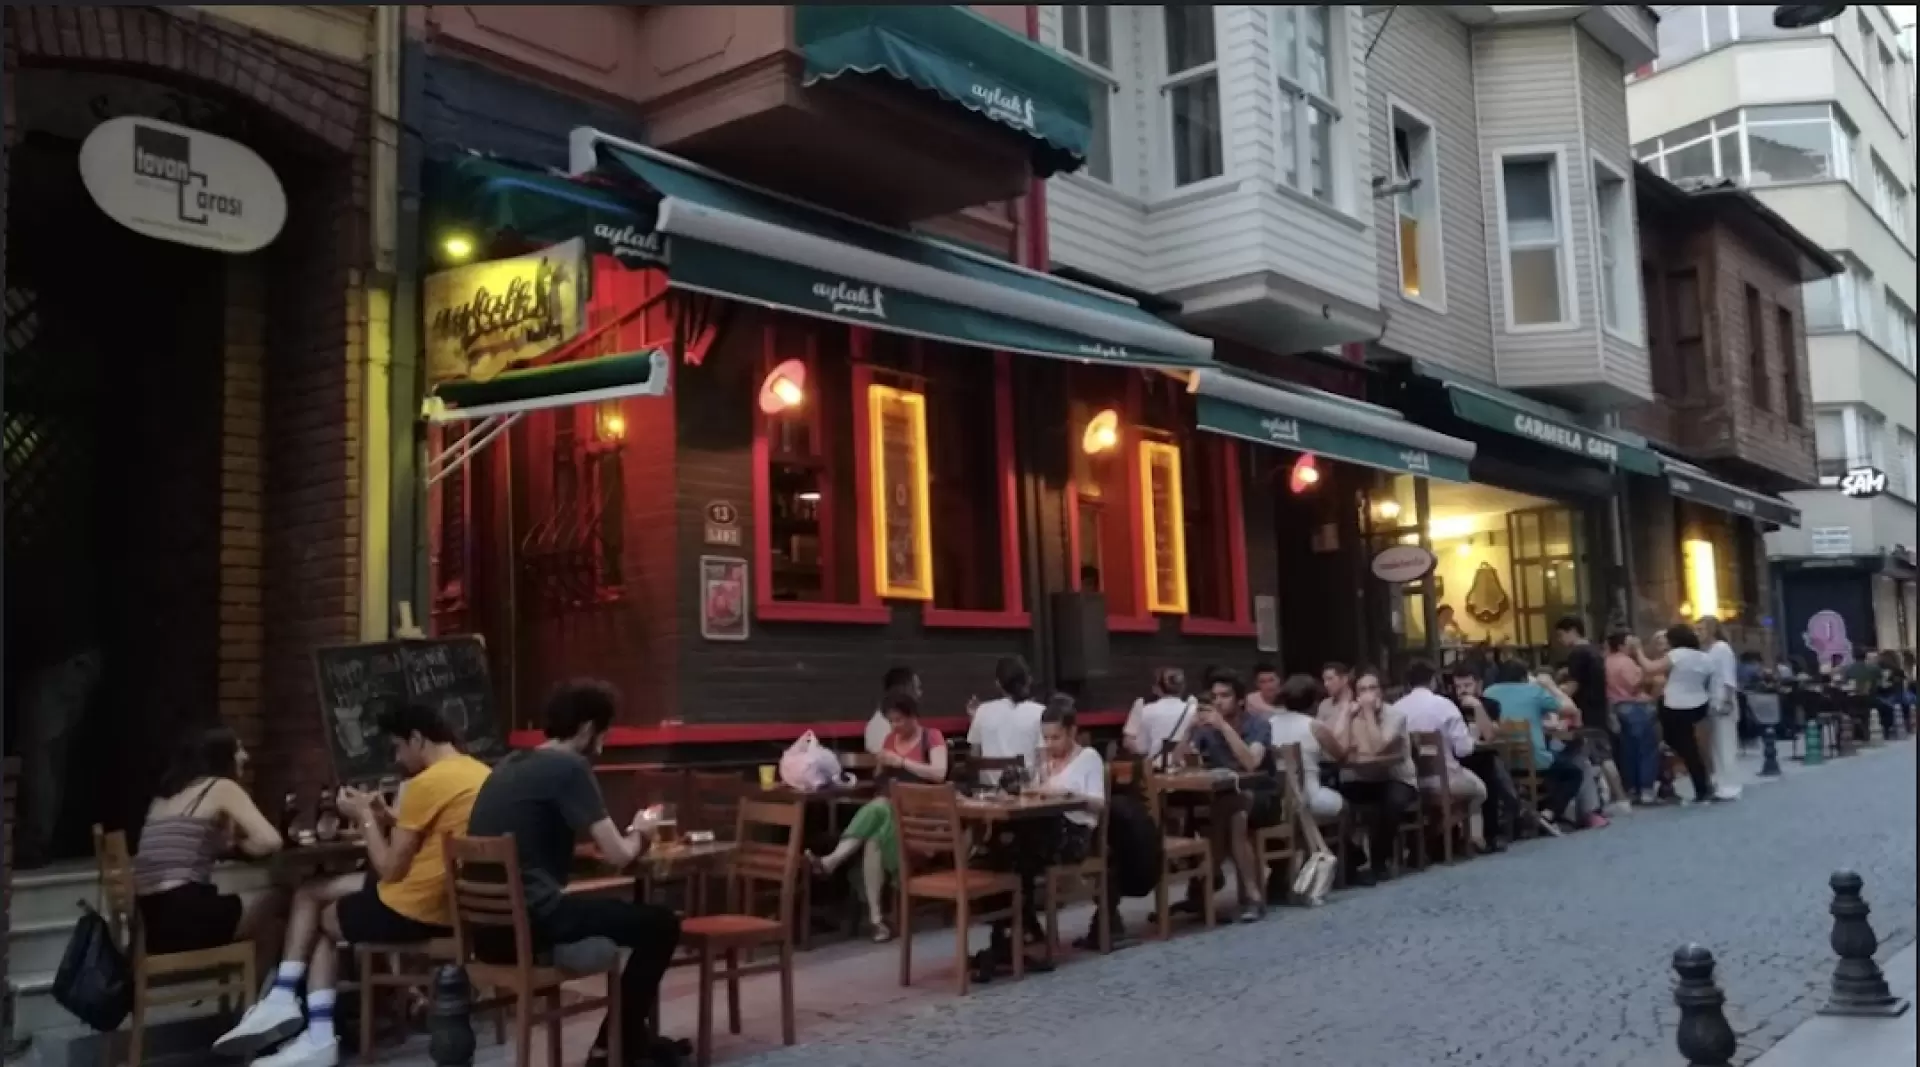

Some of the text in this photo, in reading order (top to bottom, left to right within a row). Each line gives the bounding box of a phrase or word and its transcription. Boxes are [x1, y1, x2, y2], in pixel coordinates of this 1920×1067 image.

[971, 83, 1022, 115] aylak
[135, 146, 190, 181] tavan
[593, 223, 660, 252] aylak
[812, 281, 869, 304] aylak
[1514, 413, 1582, 451] CARMELA
[1841, 471, 1886, 495] SAM
